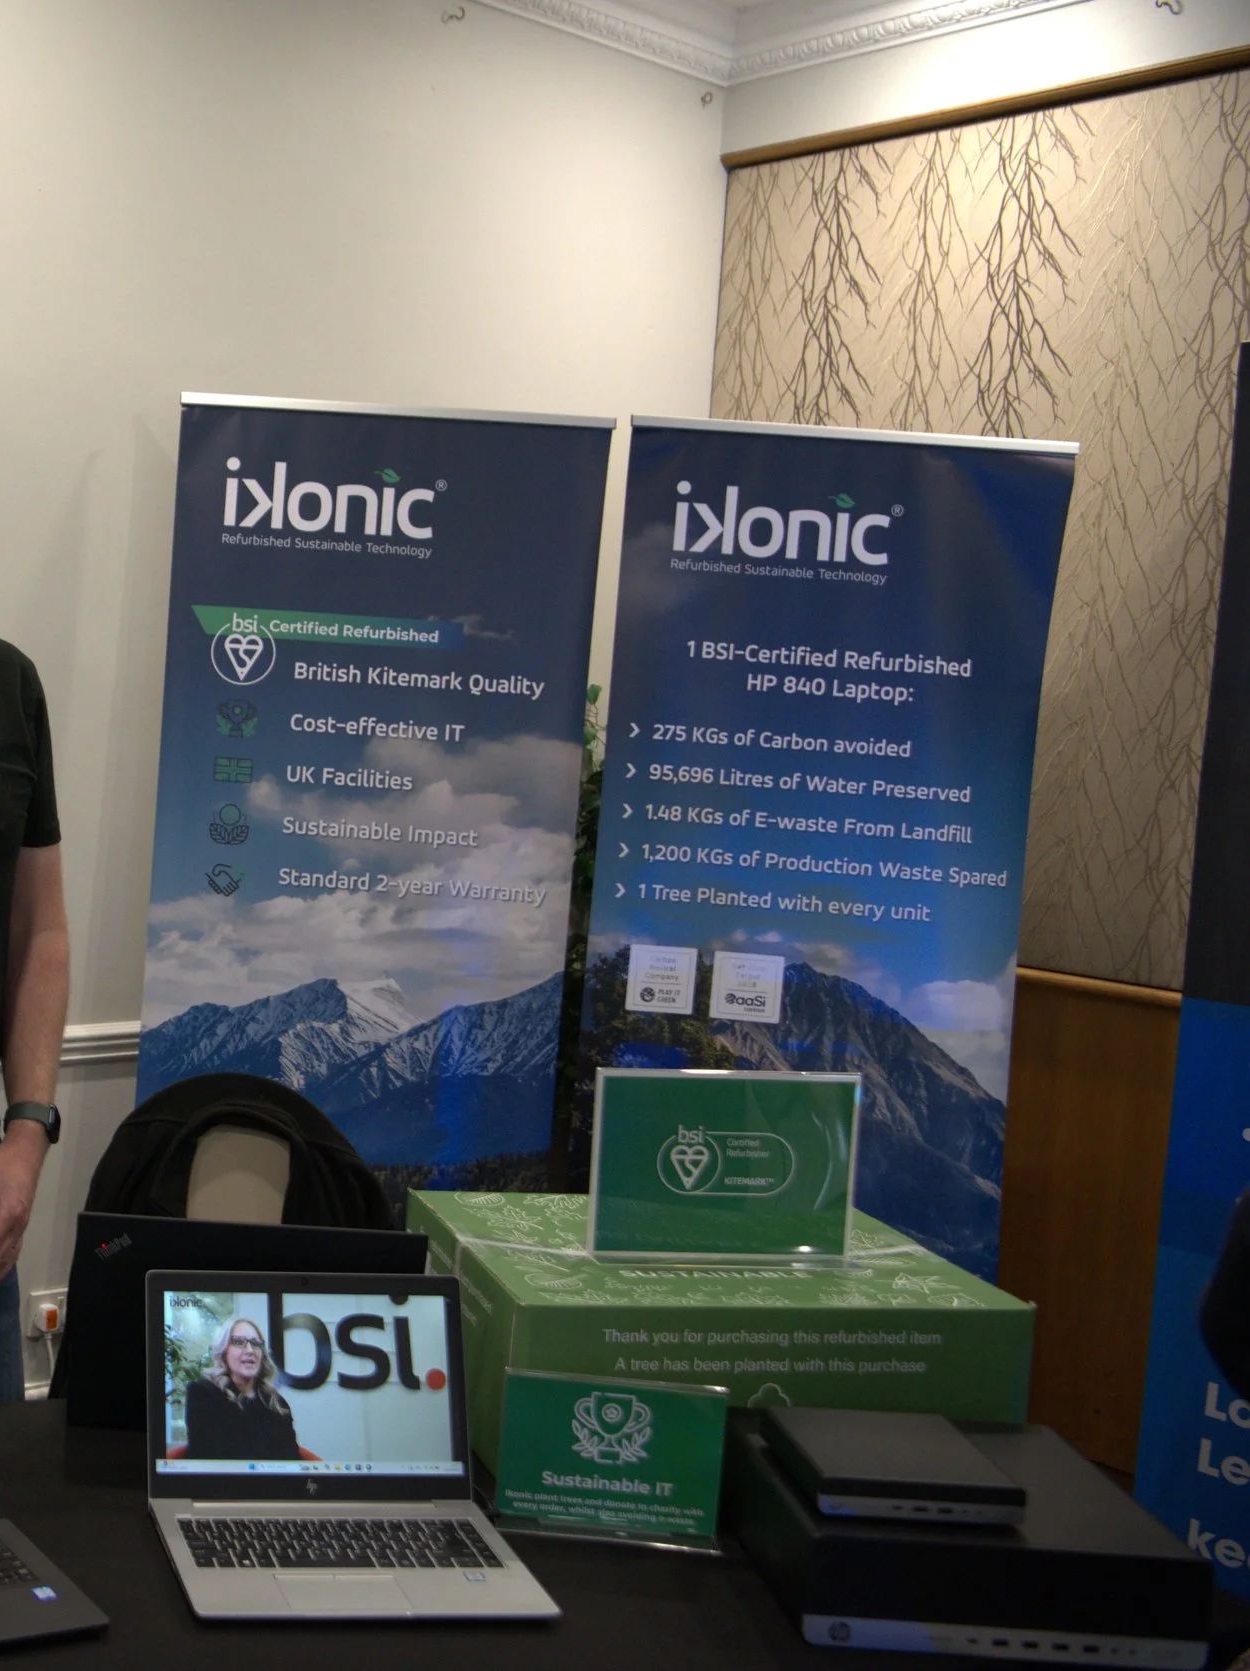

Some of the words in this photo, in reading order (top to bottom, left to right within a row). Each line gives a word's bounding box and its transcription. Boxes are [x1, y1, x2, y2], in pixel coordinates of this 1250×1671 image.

[221, 533, 291, 548] Refurbished
[295, 537, 362, 553] Sustainable
[366, 542, 433, 559] Technology
[670, 558, 741, 574] Refurbished
[745, 563, 814, 579] Sustainable
[818, 568, 888, 586] Technology
[232, 612, 258, 633] bsi
[269, 620, 338, 637] Certified
[343, 624, 440, 644] Refurbished
[687, 640, 696, 657] 1
[701, 641, 837, 668] BSI-Certified
[844, 651, 972, 677] Refurbished
[294, 662, 361, 684] British
[367, 667, 463, 690] Kitemark
[469, 673, 545, 700] Quality
[747, 674, 778, 692] HP
[783, 676, 826, 696] 840
[832, 680, 915, 706] Laptop:
[290, 714, 438, 741] Cost-effective
[444, 724, 466, 742] IT
[652, 724, 687, 742] 275
[692, 726, 728, 745] KGs
[733, 729, 756, 746] of
[759, 732, 828, 752] Carbon
[833, 737, 911, 758] avoided
[286, 765, 315, 784] UK
[322, 767, 413, 790] Facilities
[649, 764, 714, 785] 95,696
[719, 768, 773, 788] Litres
[779, 773, 802, 791] of
[806, 775, 867, 795] Water
[871, 780, 971, 803] Preserved
[282, 816, 402, 841] Sustainable
[408, 825, 478, 848] Impact
[645, 804, 682, 822] 1.48
[687, 807, 724, 826] KGs
[729, 809, 750, 827] of
[754, 812, 838, 834] E-waste
[843, 818, 894, 839] From
[900, 822, 973, 844] Landfill
[641, 843, 691, 863] 1,200
[696, 847, 733, 867] KGs
[738, 850, 760, 868] of
[764, 853, 872, 877] Production
[879, 861, 943, 883] Waste
[949, 866, 1007, 888] Spared
[278, 868, 370, 891] Standard
[376, 875, 443, 898] 2-year
[448, 880, 547, 907] Warranty
[638, 883, 646, 899] 1
[652, 884, 691, 903] Tree
[696, 886, 772, 909] Planted
[777, 893, 823, 913] with
[828, 900, 885, 922] every
[890, 903, 931, 922] unit
[677, 1124, 705, 1144] bsi
[619, 1268, 814, 1280] SUSTAINABLE
[603, 1329, 649, 1344] Thank
[652, 1332, 680, 1347] you
[683, 1329, 703, 1344] for
[707, 1329, 789, 1347] purchasing
[793, 1330, 820, 1345] this
[824, 1330, 906, 1345] refurbished
[910, 1331, 942, 1345] item
[614, 1358, 626, 1372] A
[630, 1359, 659, 1372] tree
[663, 1358, 689, 1372] has
[693, 1358, 730, 1373] been
[734, 1358, 789, 1376] planted
[793, 1358, 824, 1373] with
[828, 1358, 855, 1373] this
[859, 1358, 927, 1376] purchase
[541, 1470, 651, 1495] Sustainable
[655, 1482, 674, 1497] IT
[512, 1500, 538, 1511] every
[567, 1505, 595, 1515] whilst
[597, 1508, 615, 1518] also
[617, 1511, 657, 1524] avoiding
[560, 1495, 582, 1505] trees
[584, 1496, 602, 1506] and
[604, 1498, 636, 1510] donate
[637, 1502, 647, 1511] to
[683, 1507, 704, 1517] with
[1187, 1518, 1250, 1568] ke
